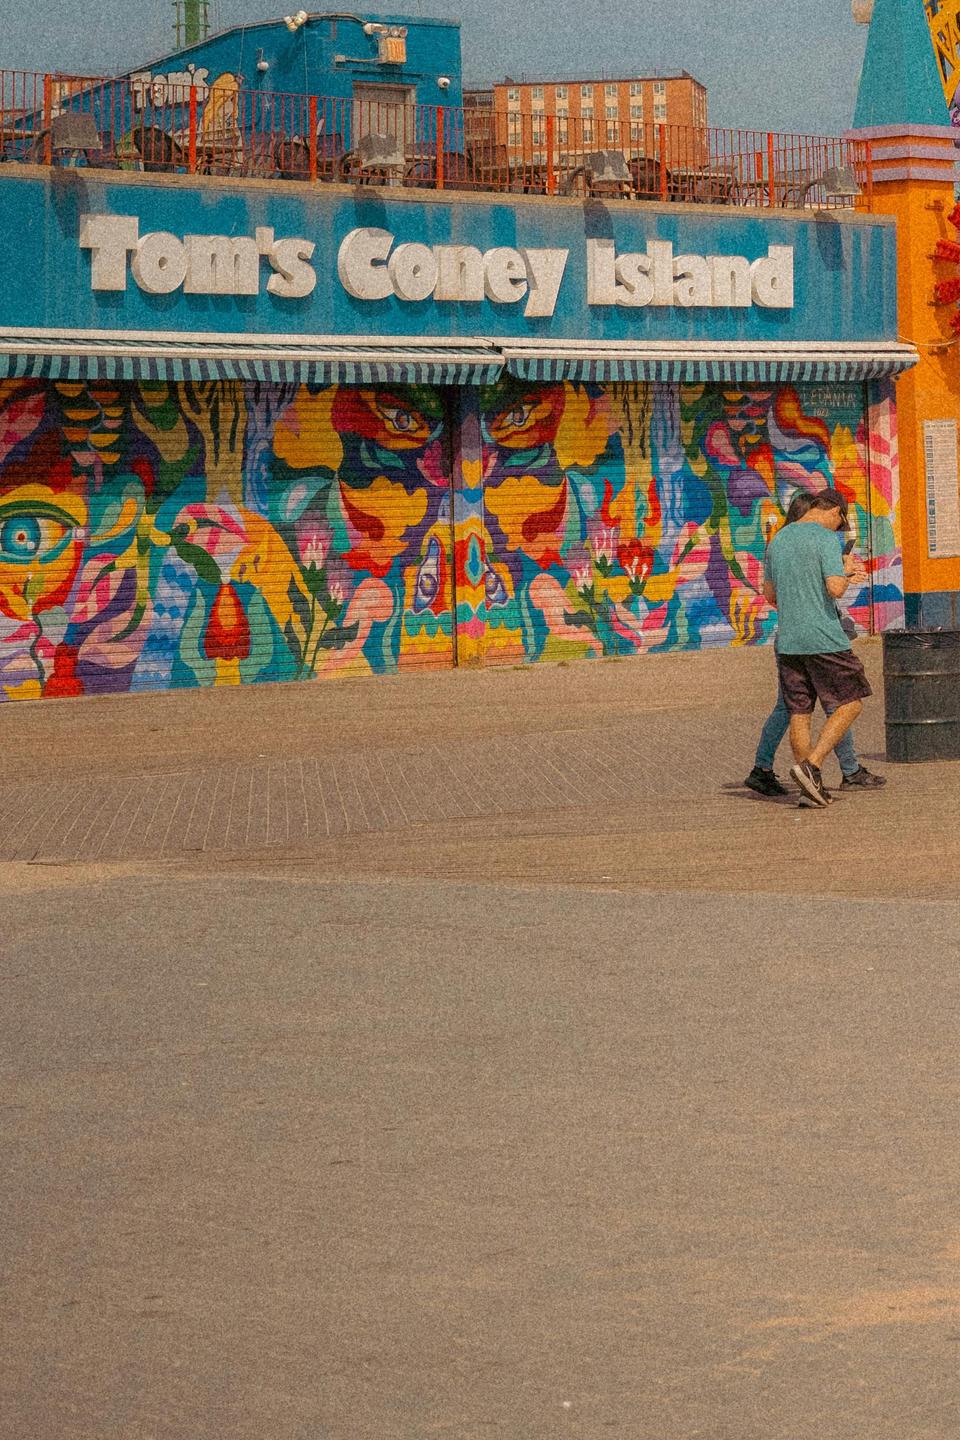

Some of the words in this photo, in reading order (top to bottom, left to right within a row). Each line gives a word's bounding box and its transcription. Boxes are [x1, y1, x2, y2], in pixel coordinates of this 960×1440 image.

[129, 63, 210, 110] Tom's
[79, 214, 317, 298] Tom's
[337, 226, 570, 317] Coney
[585, 237, 794, 309] Island
